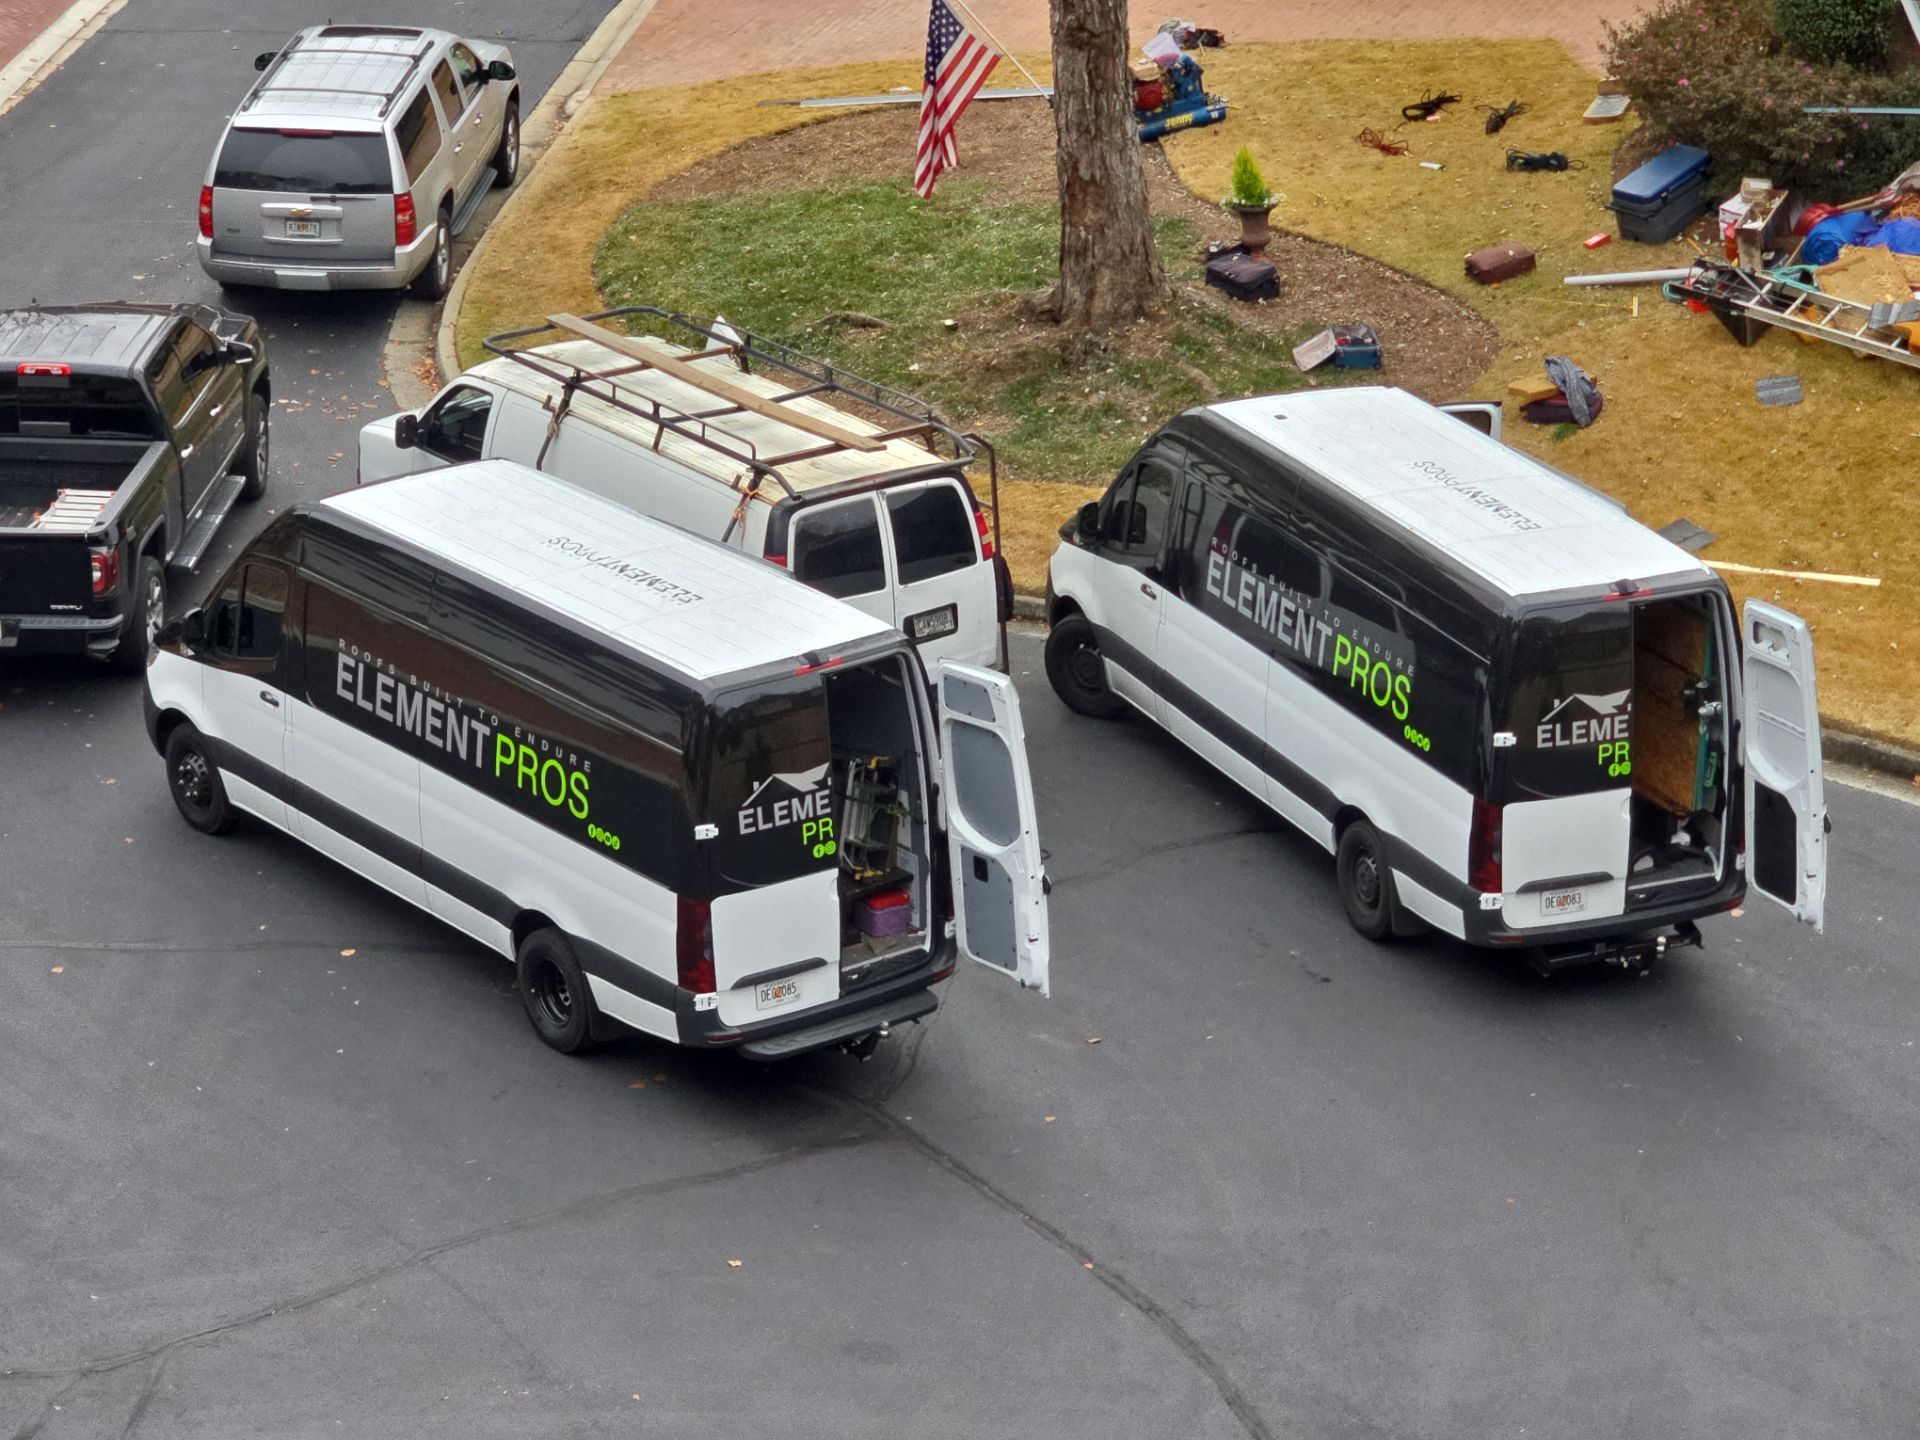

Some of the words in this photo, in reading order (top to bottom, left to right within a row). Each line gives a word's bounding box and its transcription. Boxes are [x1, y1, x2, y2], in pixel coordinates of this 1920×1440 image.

[1211, 537, 1258, 574] ROOFS
[1268, 574, 1312, 608] BUILT
[1324, 610, 1340, 627] TO
[1352, 629, 1414, 677] ENDURE
[339, 638, 396, 675] ROOFS
[410, 675, 463, 709] BUILT
[478, 708, 498, 726] TO
[515, 726, 591, 773] ENDURE
[1537, 715, 1630, 749] ELEME
[1598, 741, 1630, 765] PR
[738, 789, 832, 835] ELEME
[802, 817, 834, 845] PR
